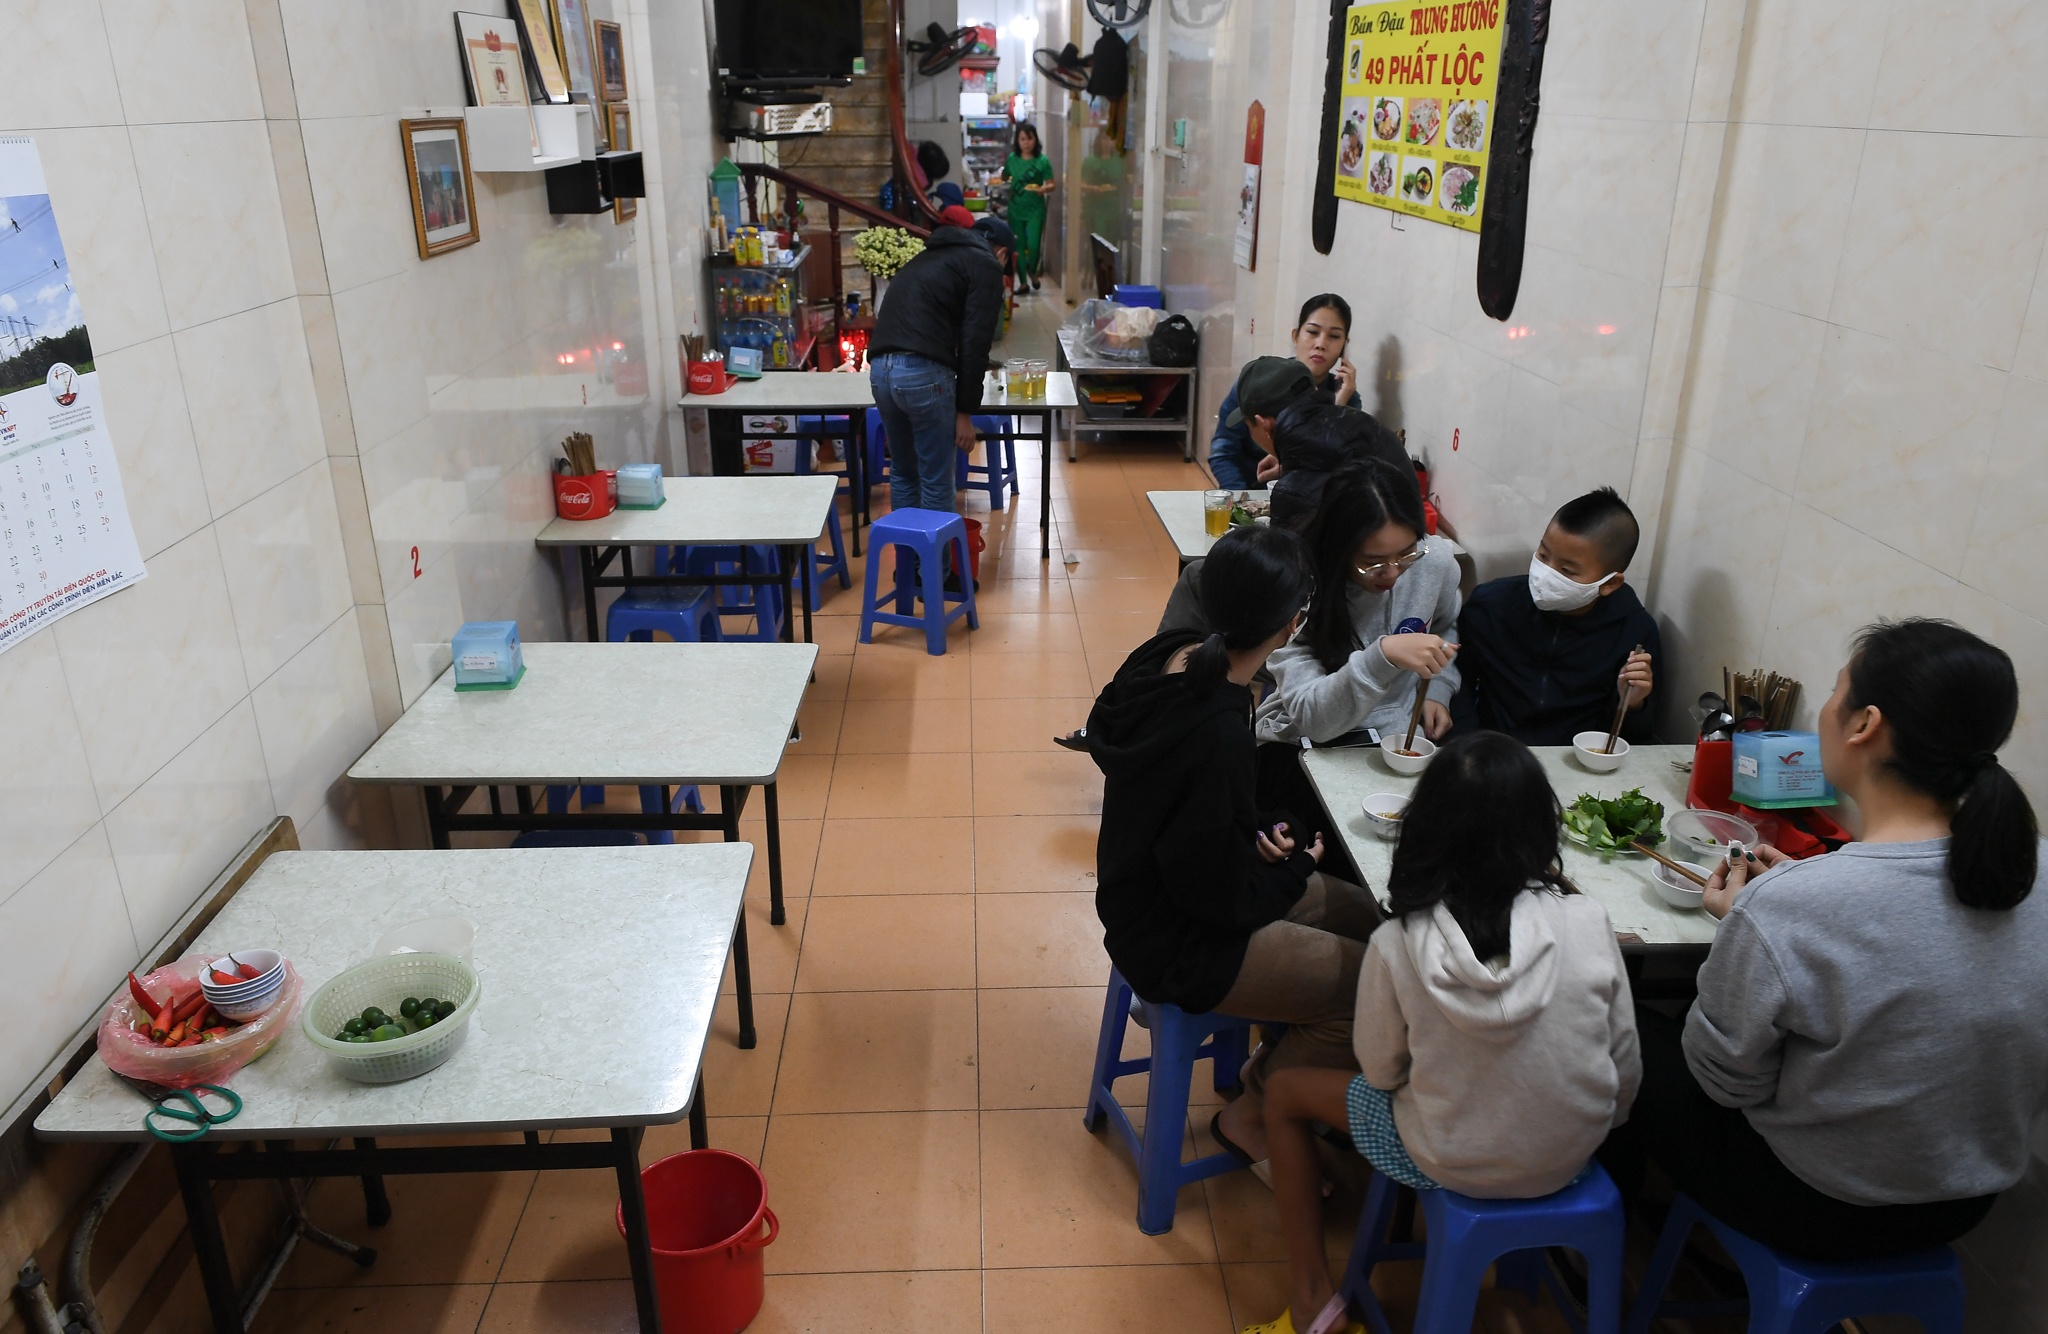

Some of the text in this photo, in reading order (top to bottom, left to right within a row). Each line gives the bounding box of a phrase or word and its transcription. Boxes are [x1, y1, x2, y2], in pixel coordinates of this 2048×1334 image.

[1350, 15, 1373, 36] Bún
[1377, 11, 1405, 36] Đậu
[1410, 5, 1448, 36] TRUNG
[1365, 57, 1384, 85] 49
[1388, 40, 1438, 85] PHẤT
[1442, 43, 1484, 96] LỘC
[1452, 428, 1460, 451] 6
[41, 482, 50, 493] 10
[65, 473, 73, 484] 11
[89, 464, 97, 475] 12
[4, 489, 103, 539] 15 16 17 18 19
[10, 515, 110, 567] 22 23 24 25 26
[411, 545, 422, 579] 2
[9, 609, 26, 623] CÔNG
[26, 604, 33, 614] TY
[33, 594, 55, 609] TRUYỀN
[54, 587, 63, 598] TẢI
[64, 582, 78, 593] ĐIỆN
[78, 573, 95, 587] QUỐC
[96, 568, 107, 578] GIA
[16, 570, 47, 594] 29 30
[48, 598, 64, 612] CÔNG
[64, 590, 81, 604] TRÌNH
[82, 583, 95, 595] ĐIỆN
[96, 576, 110, 588] MIỀN
[111, 571, 123, 582] BẮC
